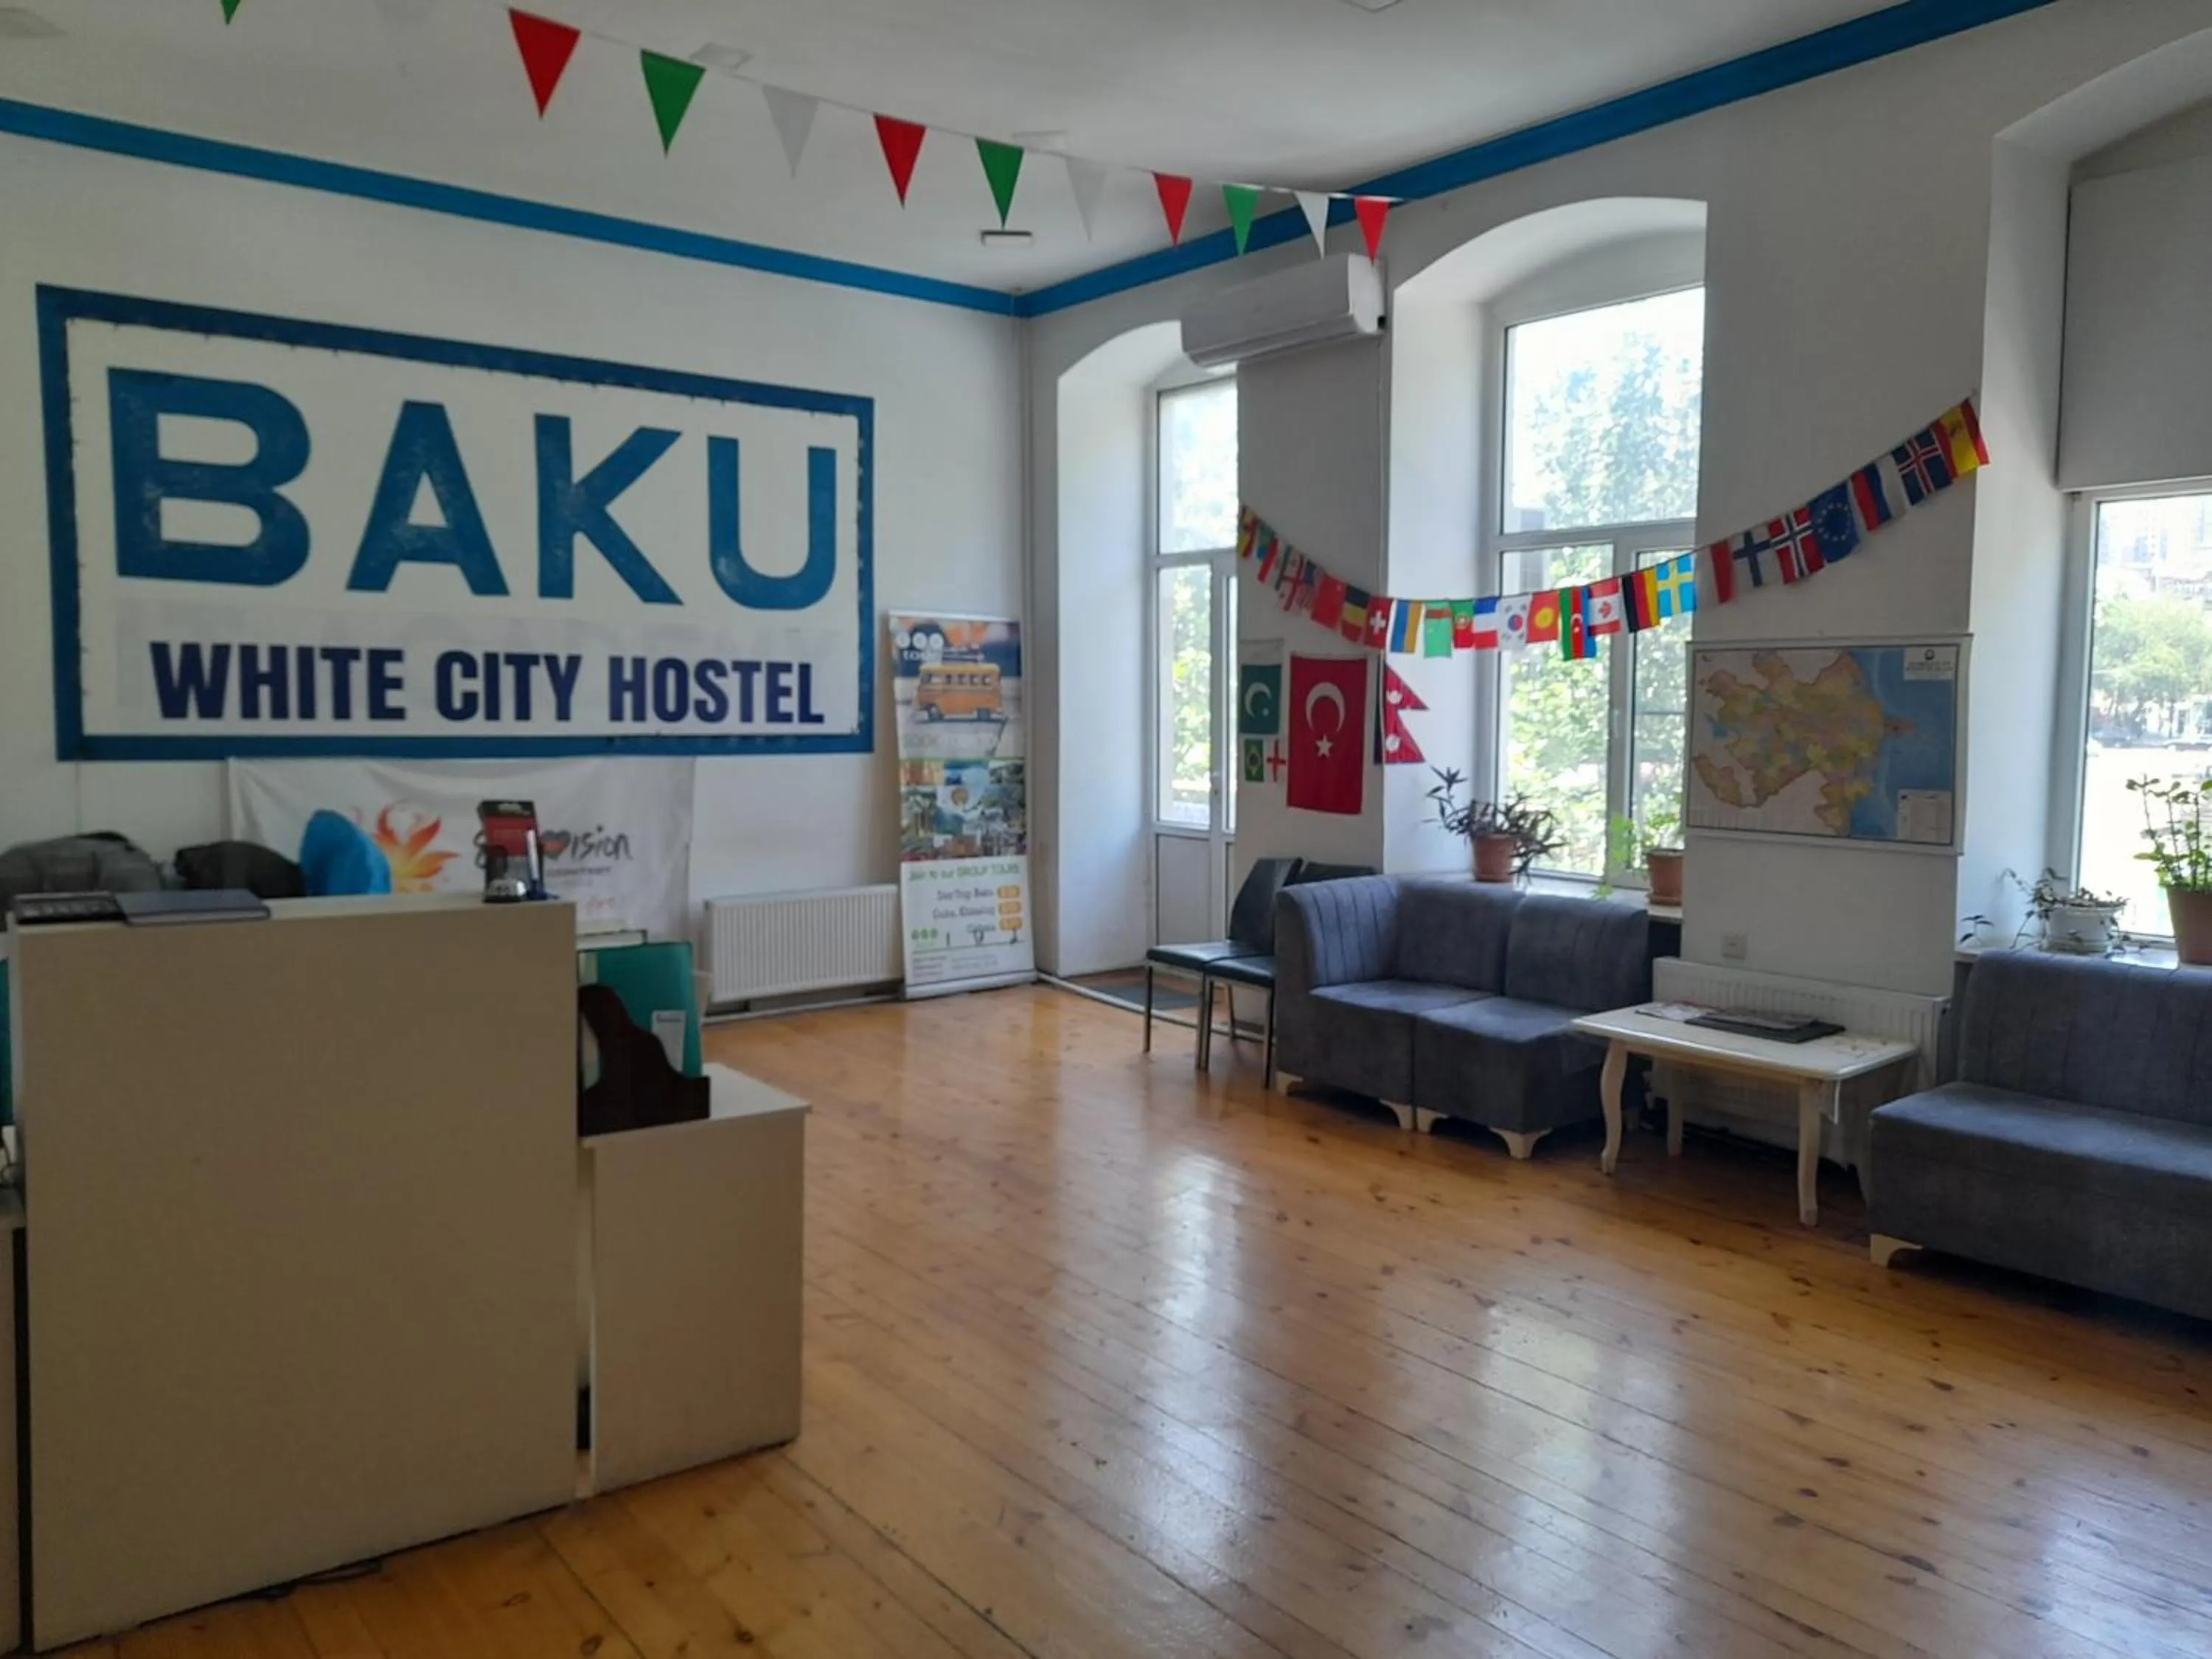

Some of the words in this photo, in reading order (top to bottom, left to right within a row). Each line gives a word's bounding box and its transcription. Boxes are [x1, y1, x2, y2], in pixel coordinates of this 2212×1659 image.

[107, 366, 837, 611] BAKU
[150, 641, 406, 720] WHITE
[436, 651, 581, 721] CITY
[610, 657, 824, 723] HOSTEL
